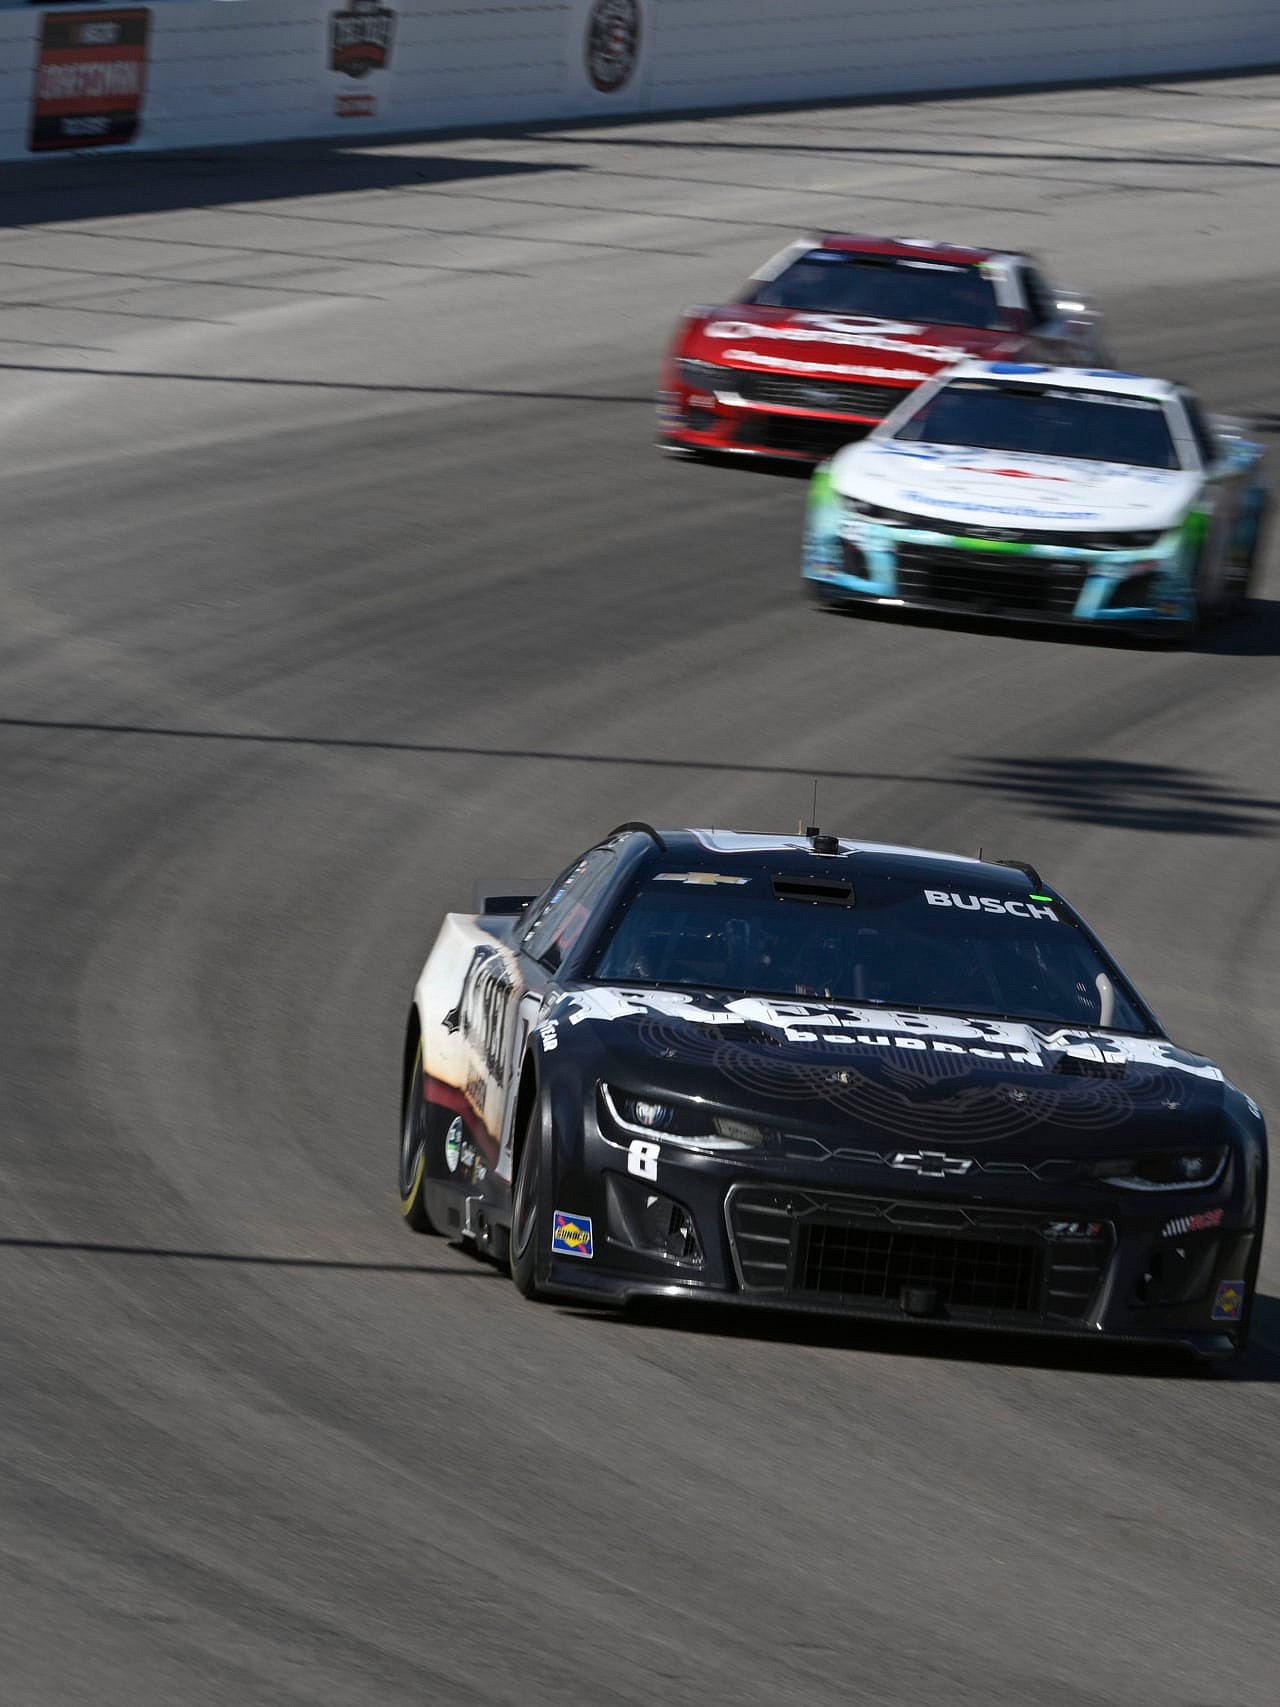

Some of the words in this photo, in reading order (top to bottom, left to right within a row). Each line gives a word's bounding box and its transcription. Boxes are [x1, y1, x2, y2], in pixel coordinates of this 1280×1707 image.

[924, 889, 1060, 923] BUSCH
[627, 1139, 661, 1182] 8
[554, 1224, 591, 1246] SUNOCO
